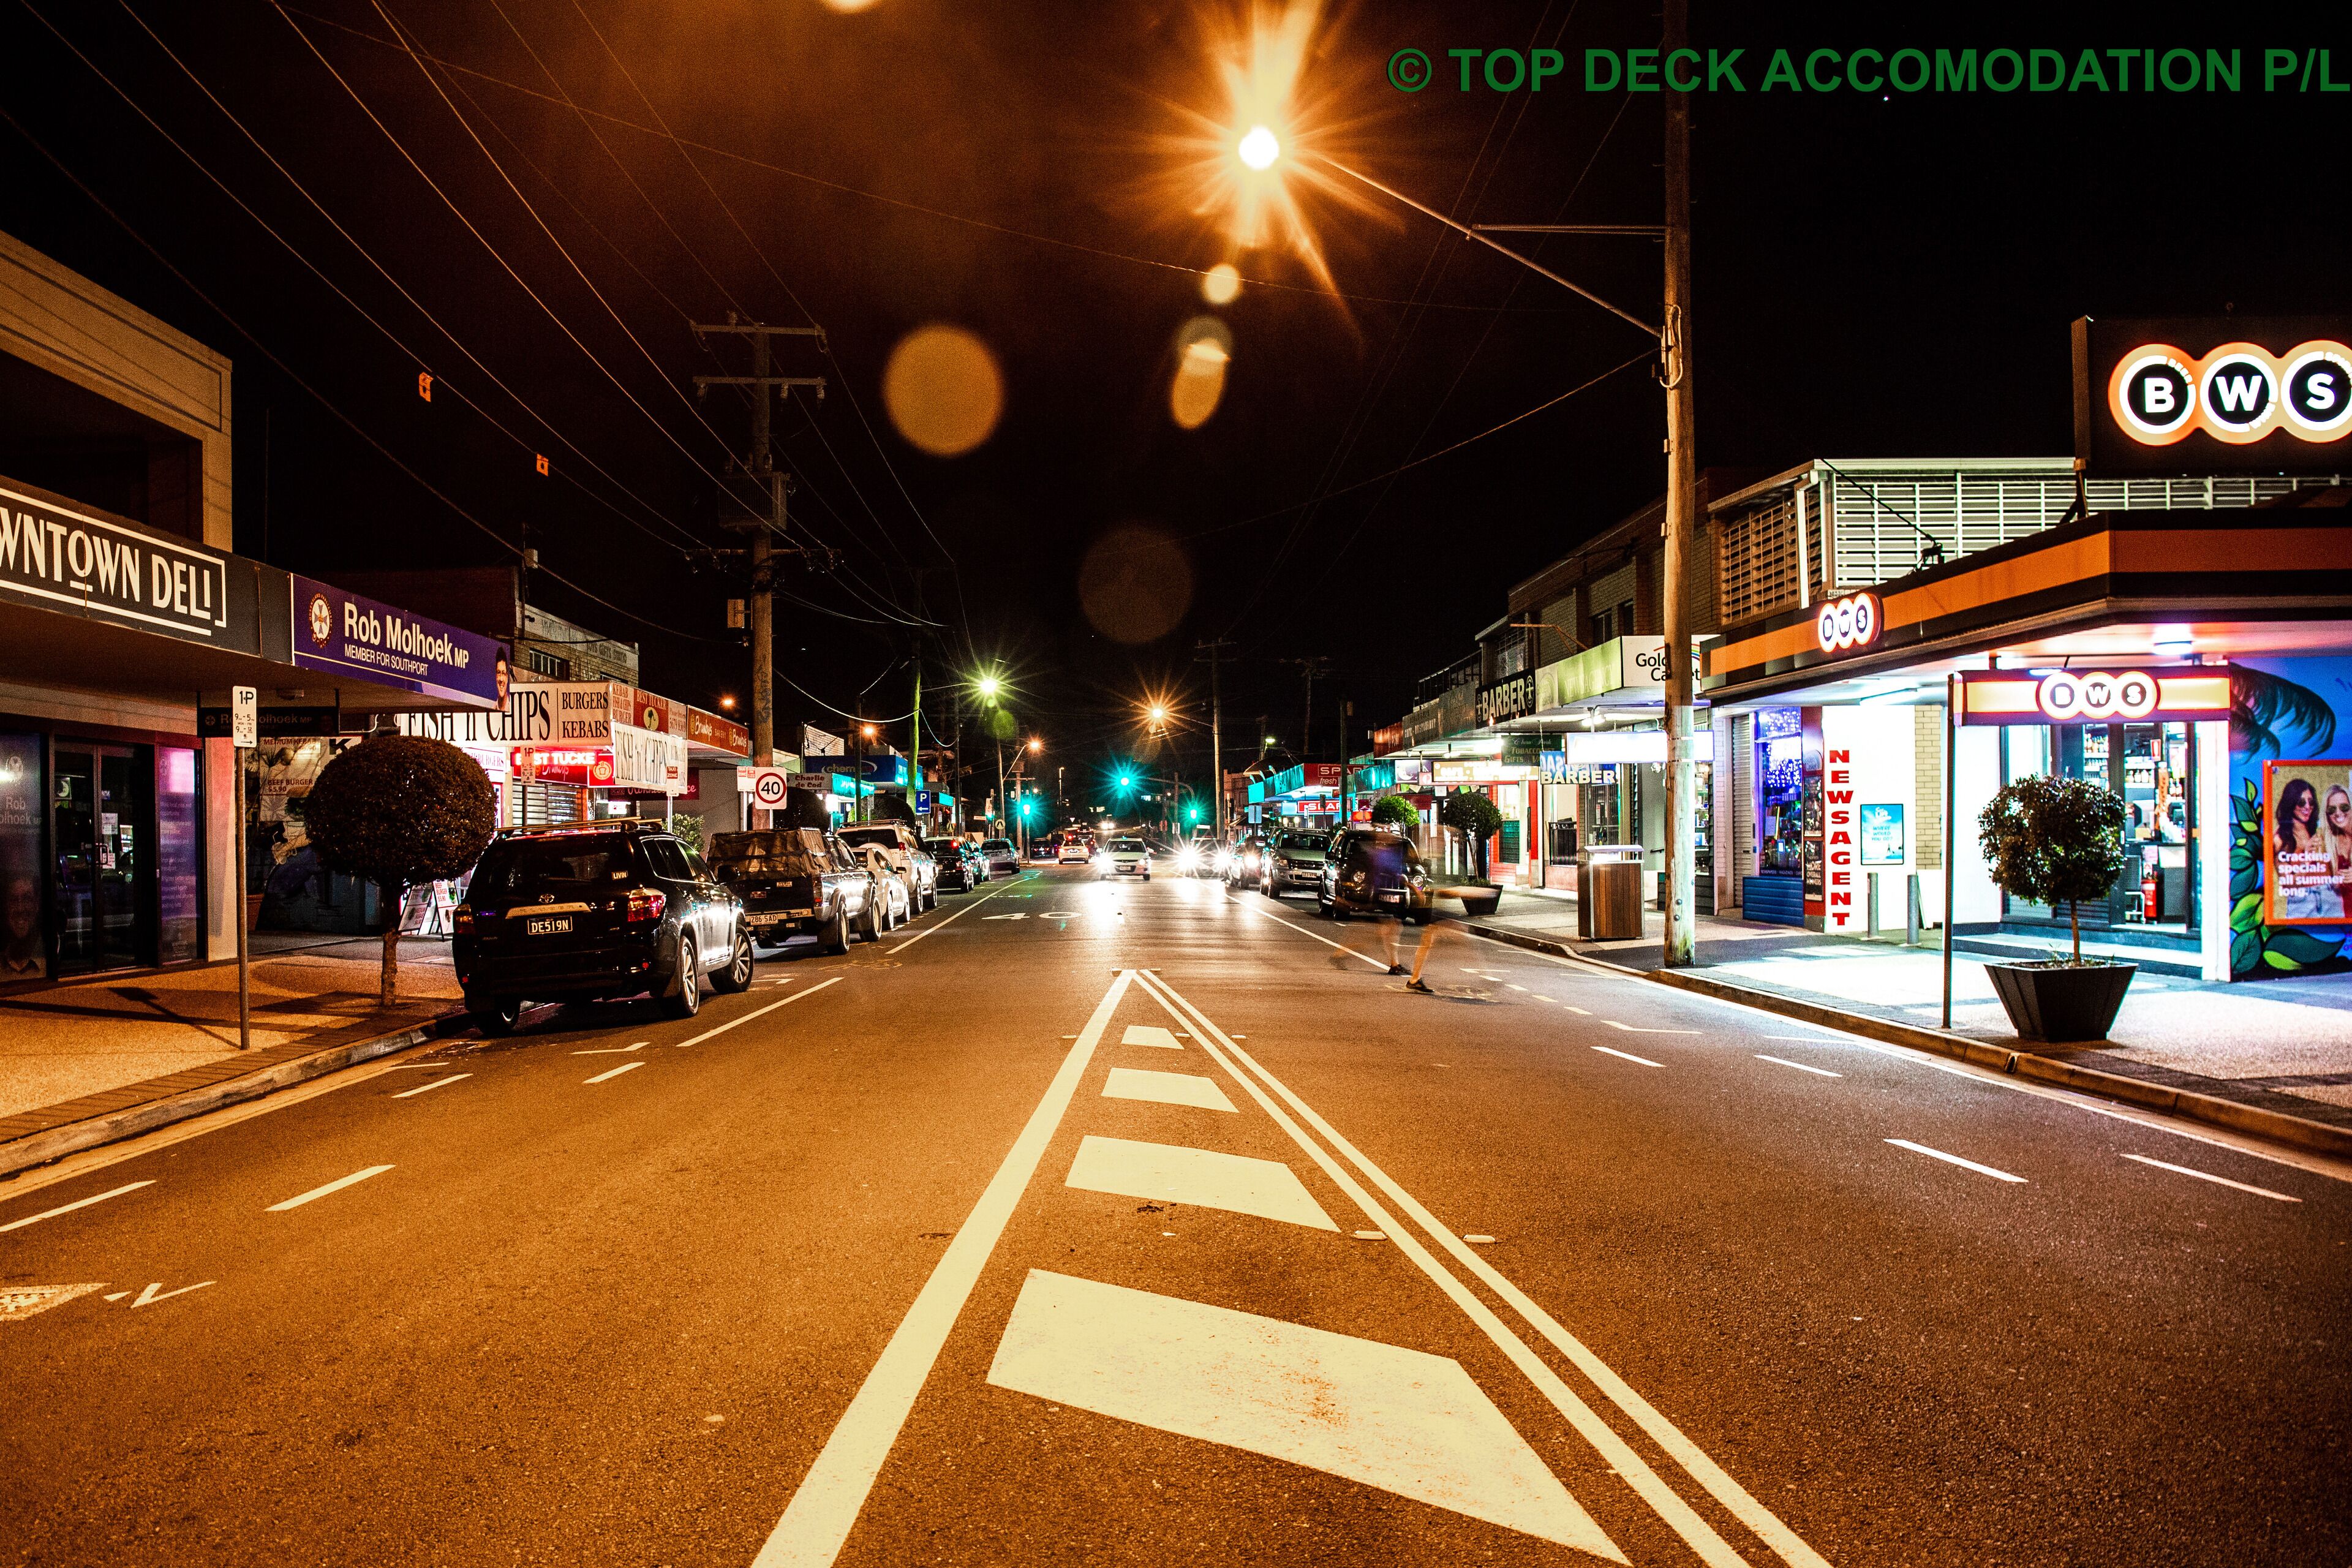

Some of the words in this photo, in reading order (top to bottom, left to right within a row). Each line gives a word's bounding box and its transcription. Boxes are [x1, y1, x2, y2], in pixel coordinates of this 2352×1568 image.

[2144, 372, 2336, 413] BWS
[152, 554, 211, 620] DELI
[344, 601, 381, 646] Rob
[386, 614, 453, 666] Molhoek
[454, 647, 469, 669] MP
[345, 643, 375, 663] MEMBER
[376, 651, 390, 667] FOR
[391, 654, 429, 676] SOUTHPORT
[239, 690, 254, 705] 1P
[612, 683, 628, 698] KEBAB
[2054, 685, 2143, 707] BWS
[561, 691, 608, 710] BURGERS
[636, 690, 647, 704] BEST
[647, 694, 666, 710] TUCKER
[1482, 677, 1526, 721] BARBER
[258, 713, 298, 724] olhoek
[612, 709, 631, 724] BURGER
[562, 720, 609, 739] KEBABS
[524, 747, 534, 757] 1P
[1540, 771, 1616, 784] BARBER
[761, 781, 780, 795] 40
[6, 797, 26, 810] Rob
[920, 793, 927, 802] P
[1826, 749, 1854, 926] NEWSAGENT
[2278, 850, 2331, 862] Cracking
[1807, 861, 1821, 870] MORE
[2278, 862, 2327, 875] specials
[2278, 875, 2294, 885] all
[2296, 875, 2345, 885] summer
[2278, 886, 2309, 897] long.
[981, 911, 1082, 920] 40
